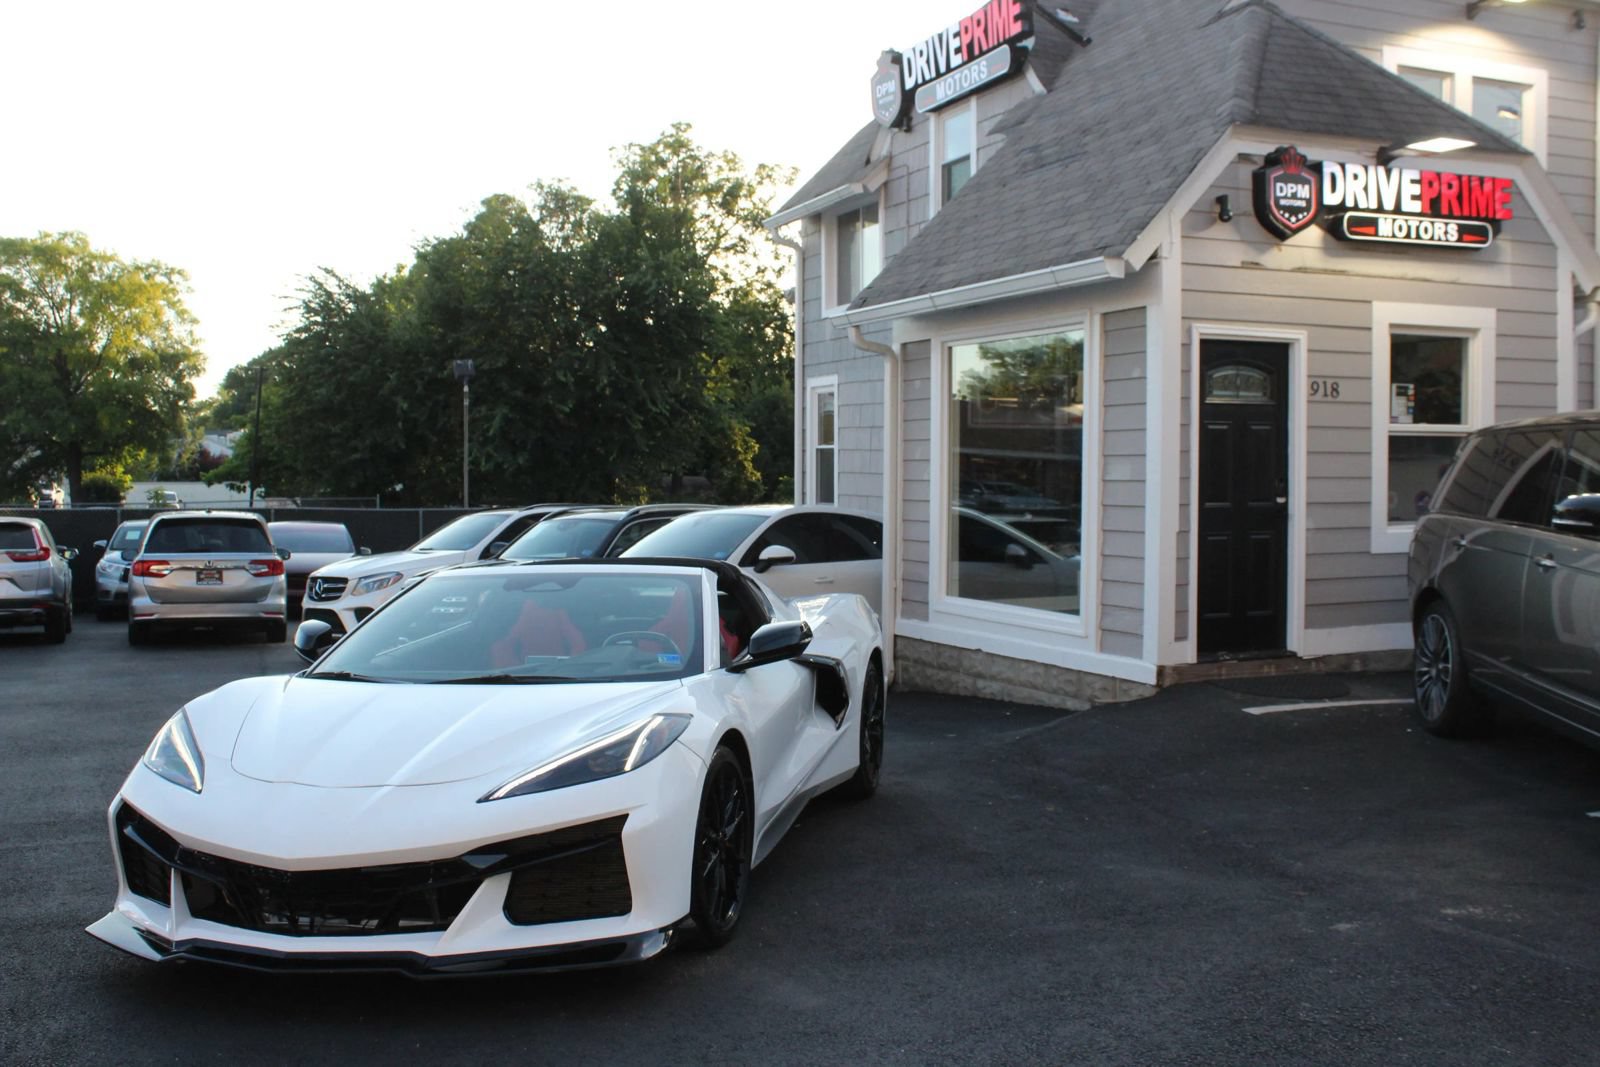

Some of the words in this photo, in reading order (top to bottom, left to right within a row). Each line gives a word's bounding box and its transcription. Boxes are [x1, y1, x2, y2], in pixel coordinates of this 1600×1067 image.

[876, 79, 896, 98] DPM
[935, 60, 988, 101] MOTORS
[1275, 181, 1310, 199] DPM
[1377, 217, 1459, 242] MOTORS
[1309, 380, 1340, 399] 918
